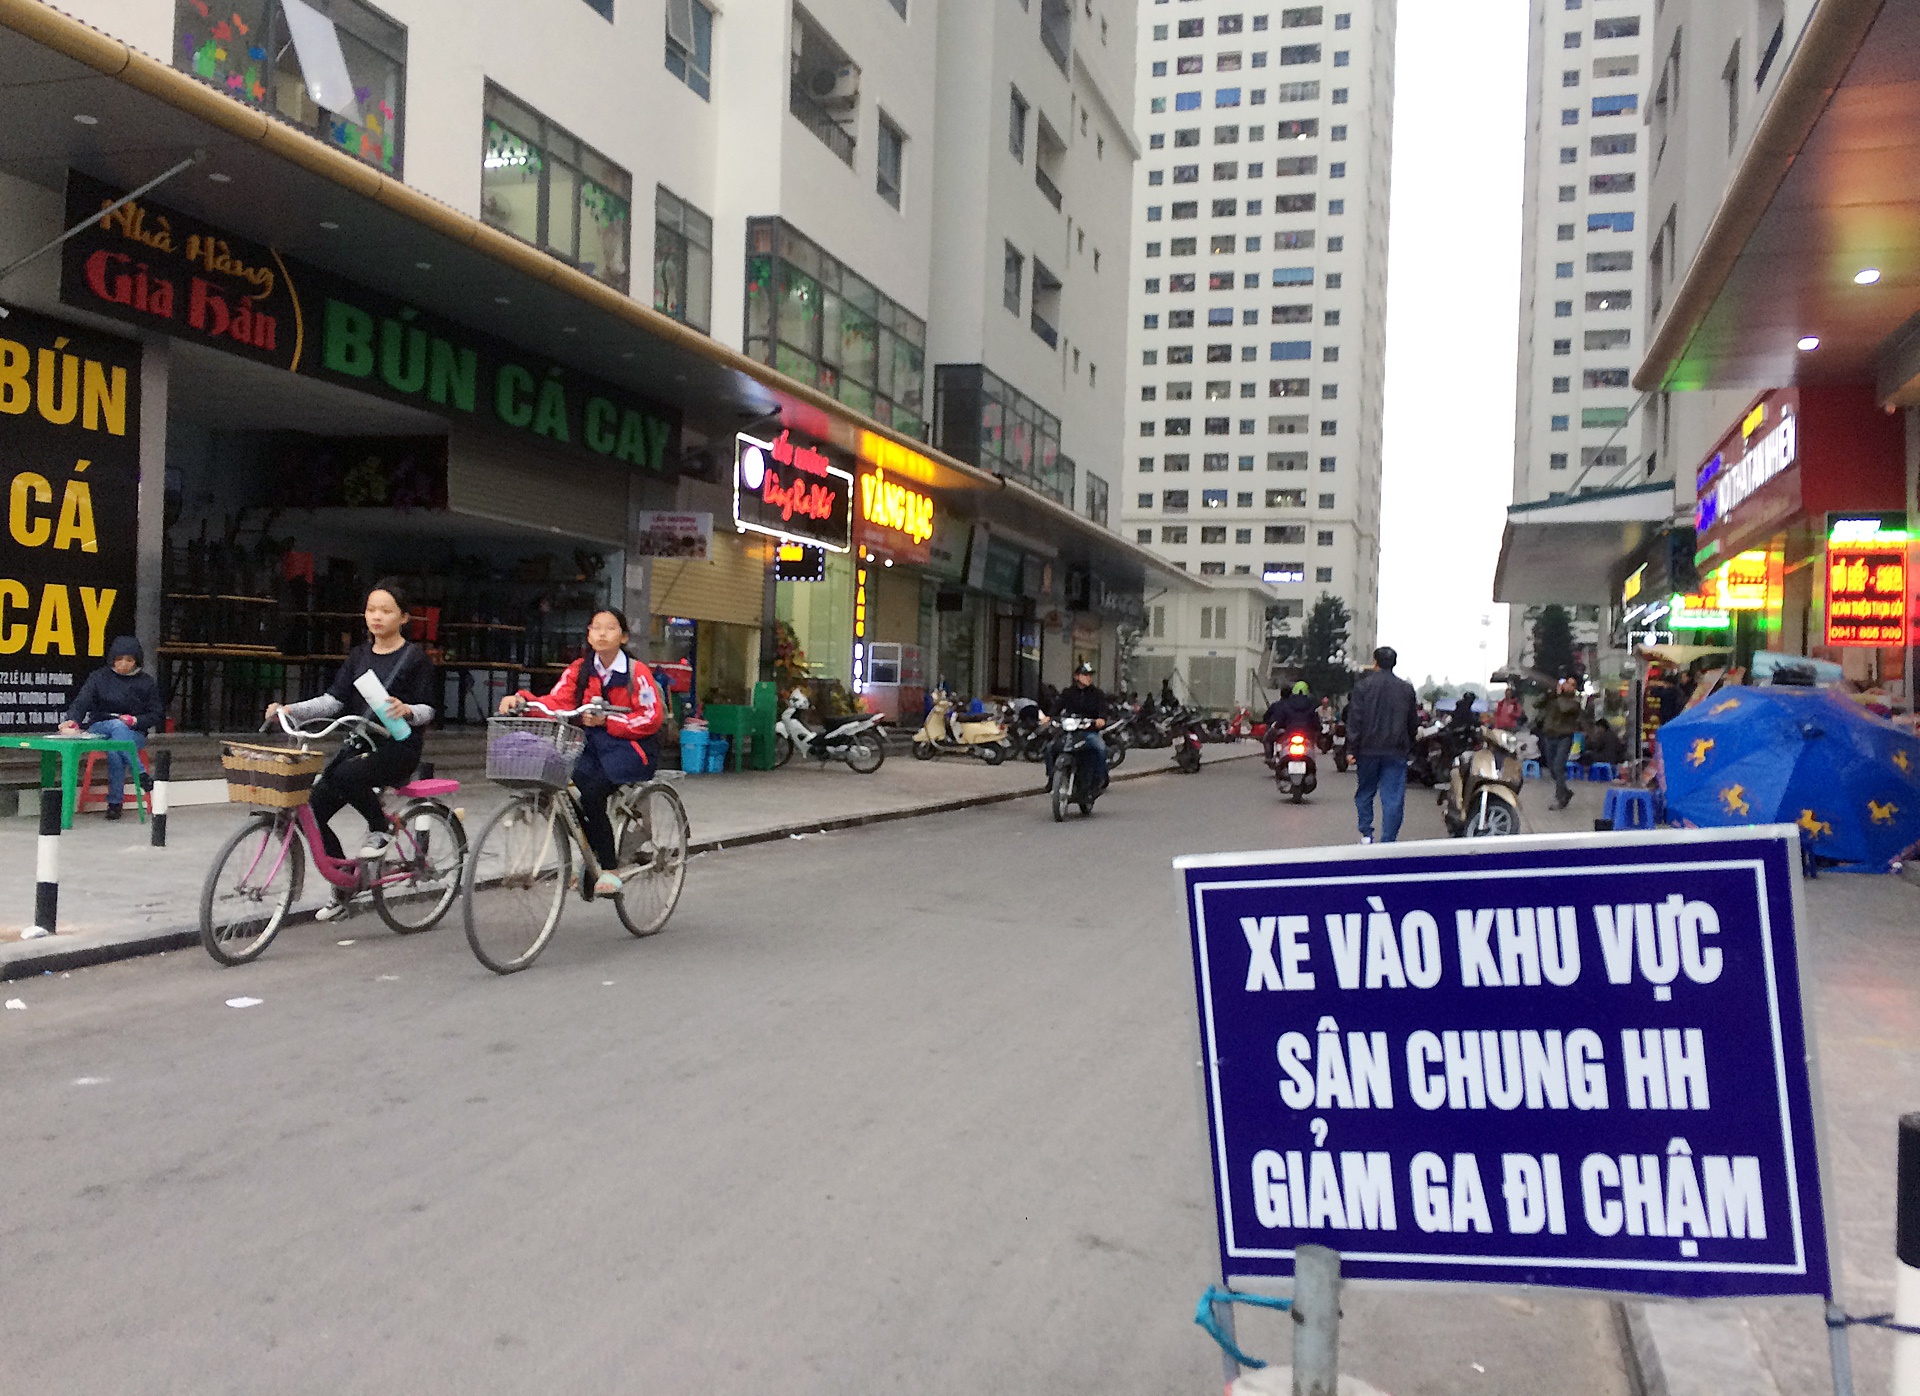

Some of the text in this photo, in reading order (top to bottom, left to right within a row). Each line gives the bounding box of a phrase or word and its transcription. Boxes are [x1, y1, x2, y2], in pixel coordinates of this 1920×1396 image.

[84, 250, 173, 319] Gia
[101, 199, 274, 300] Nhà Hàng
[0, 336, 126, 436] BÚN
[322, 299, 671, 471] BÚN CÁ CAY
[9, 459, 98, 553] CÁ
[0, 578, 117, 656] CAY
[1239, 892, 1724, 1001] XE VÀO KHU VỰC
[1276, 1015, 1711, 1111] SÂN CHUNG HH
[1250, 1117, 1768, 1258] GIẢM GA ĐI CHẬM
